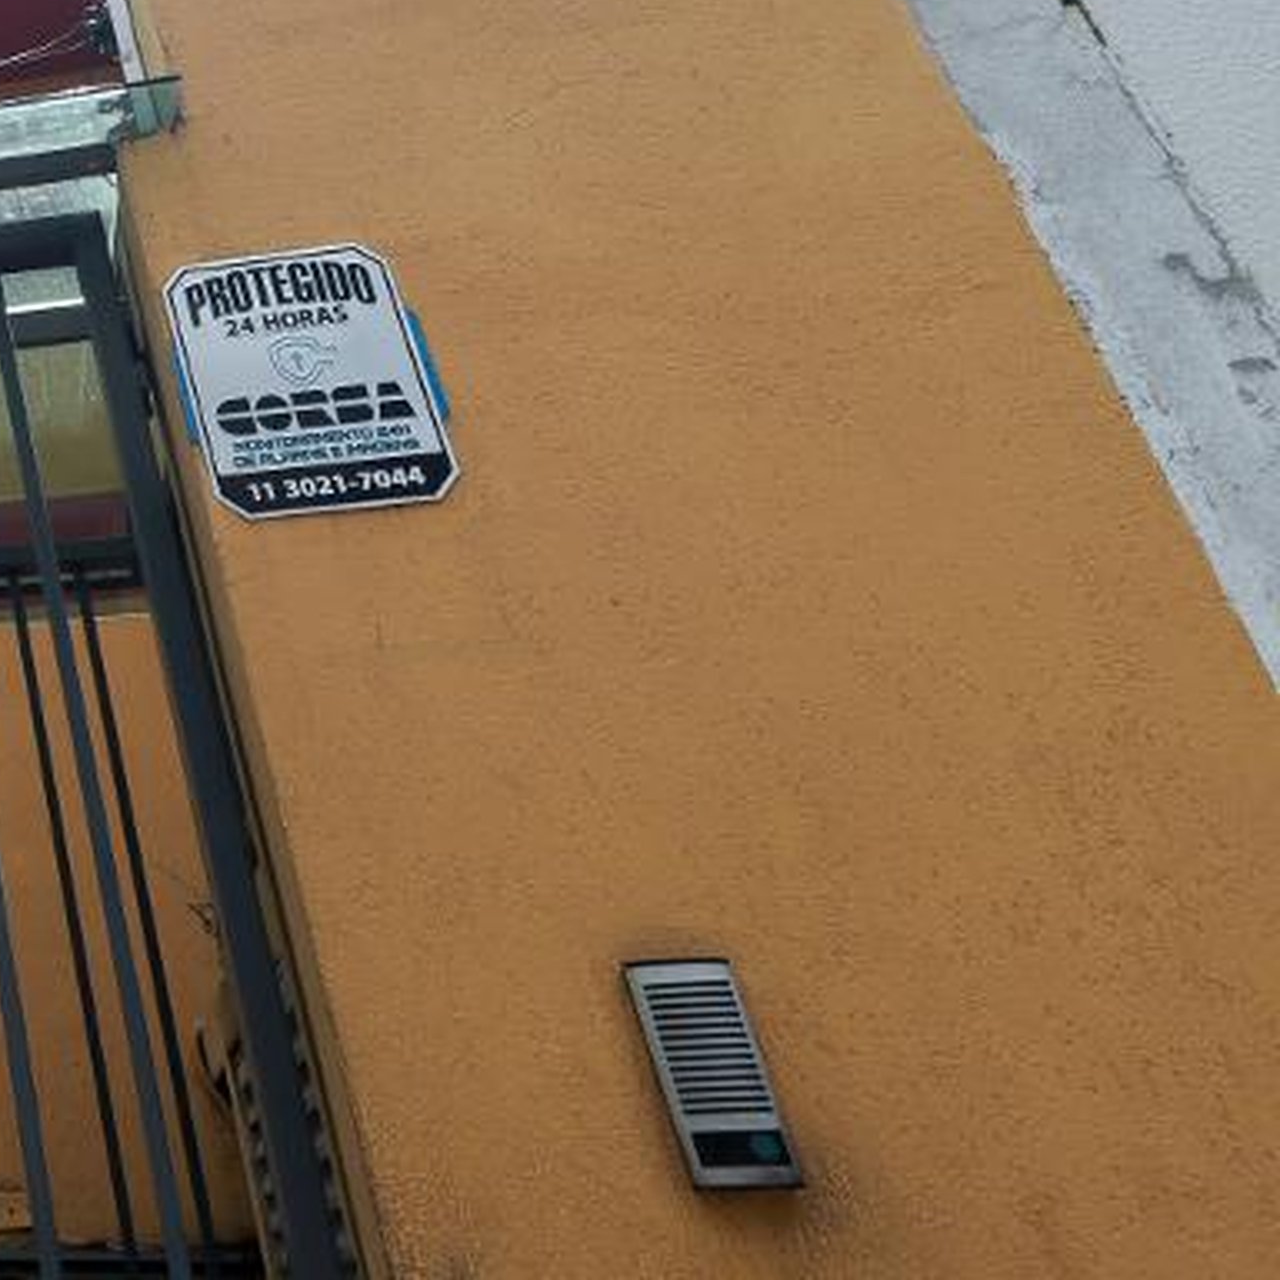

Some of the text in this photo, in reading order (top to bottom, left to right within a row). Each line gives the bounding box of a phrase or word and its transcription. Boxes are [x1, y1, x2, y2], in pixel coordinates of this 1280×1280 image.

[185, 261, 377, 327] PROTEGIDO
[225, 305, 348, 337] 24 HORAS
[249, 465, 426, 502] 11 3021-7044
